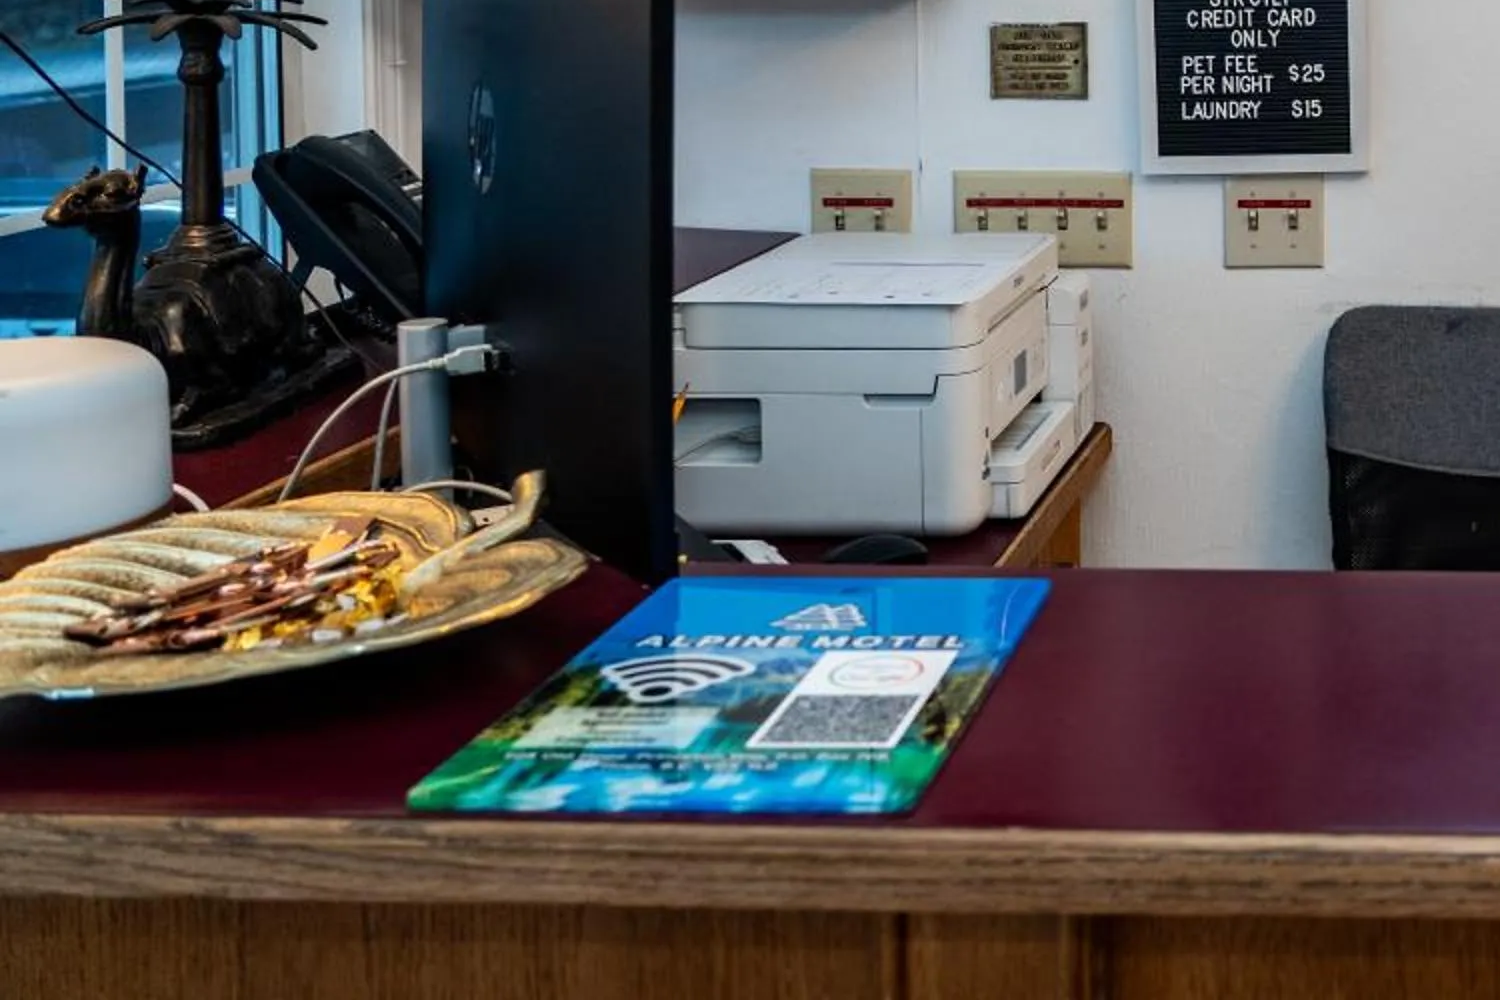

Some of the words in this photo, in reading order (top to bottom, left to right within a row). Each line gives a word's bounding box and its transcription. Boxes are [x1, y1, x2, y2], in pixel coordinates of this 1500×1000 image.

[1186, 9, 1255, 28] CREDIT
[1267, 8, 1316, 27] CARD
[1231, 29, 1280, 48] ONLY
[1182, 55, 1216, 74] PET
[1225, 55, 1258, 74] FEE
[1180, 76, 1215, 95] PER
[1222, 75, 1274, 94] NIGHT
[1181, 101, 1261, 120] LAUNDRY
[636, 634, 804, 649] ALPINE
[813, 634, 965, 649] MOTEL
